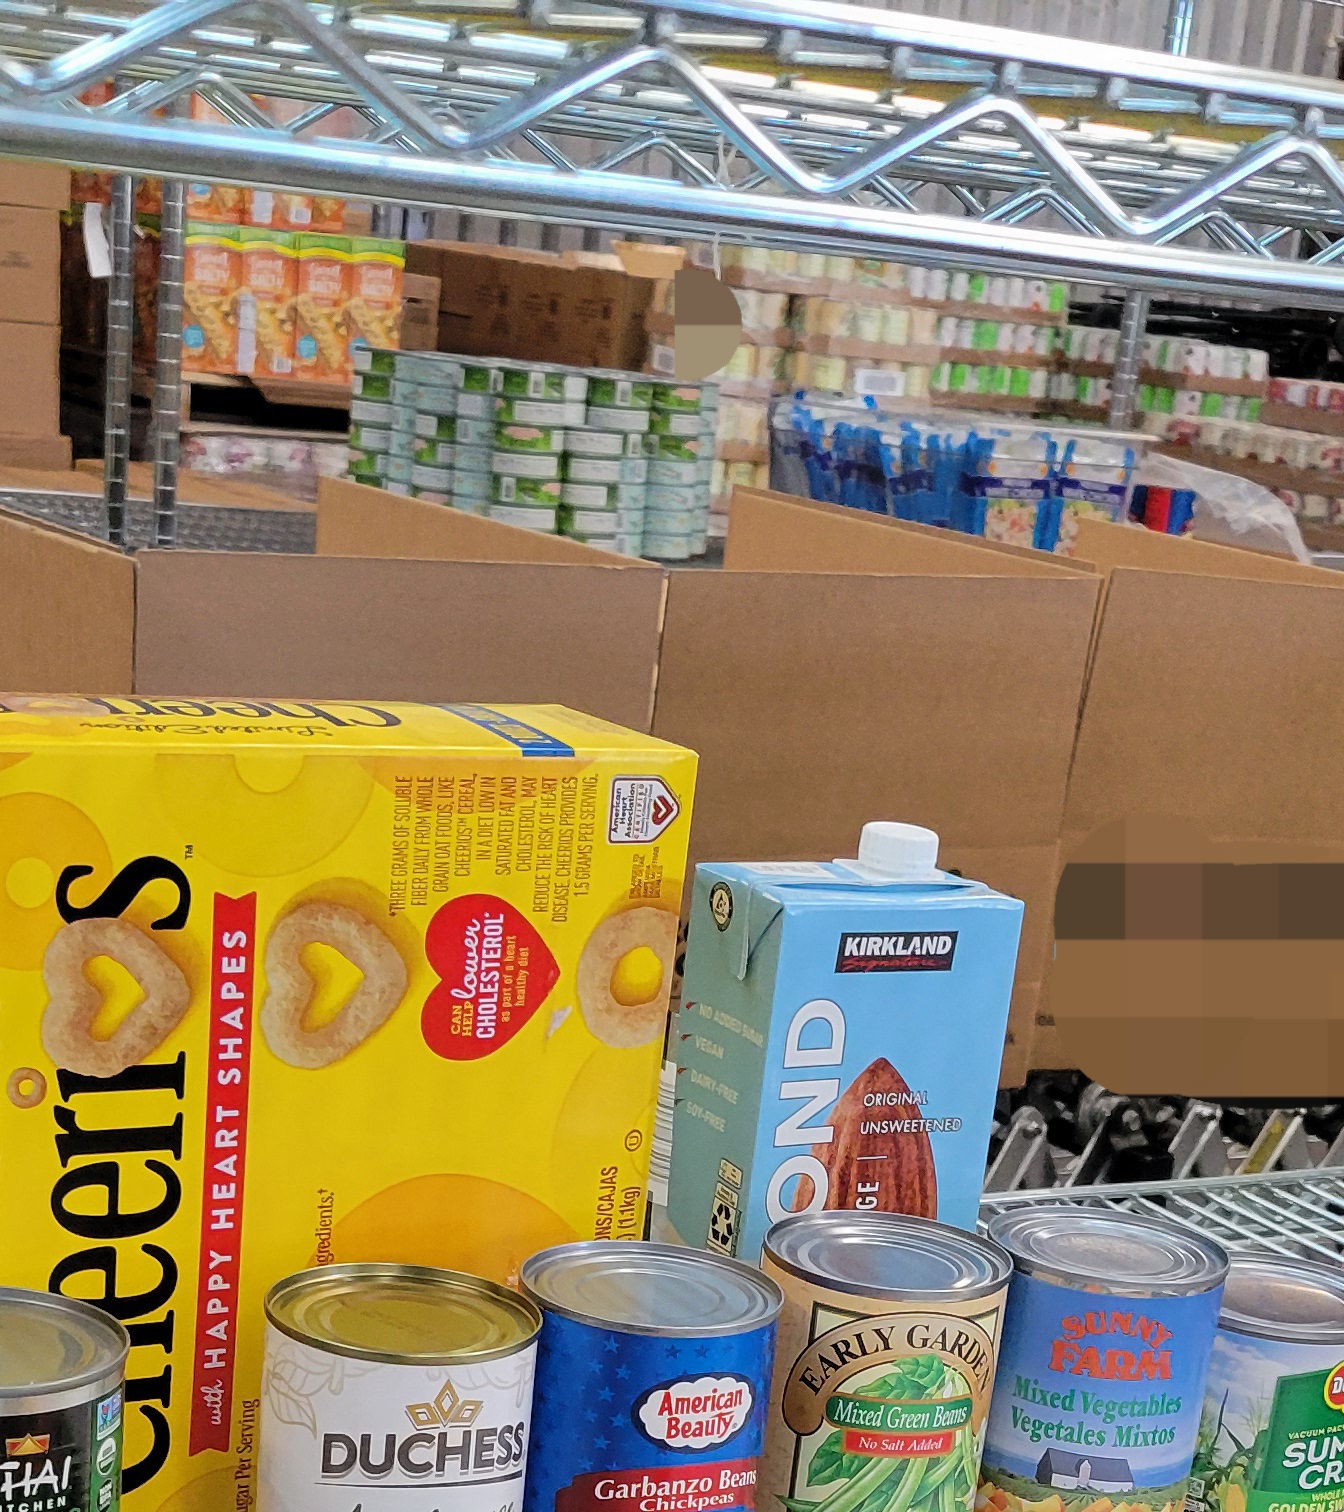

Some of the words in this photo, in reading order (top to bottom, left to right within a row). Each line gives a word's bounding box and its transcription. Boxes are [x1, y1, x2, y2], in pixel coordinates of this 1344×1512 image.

[417, 776, 433, 813] WHOLE
[520, 777, 537, 797] MAY
[612, 788, 621, 833] American
[625, 783, 635, 838] Association
[415, 817, 431, 844] FROM
[414, 848, 430, 874] DAILY
[412, 878, 428, 906] FIBER
[452, 919, 480, 1001] lower
[844, 935, 952, 957] KIRKLAND
[217, 931, 250, 1085] SHAPES
[450, 1005, 462, 1034] CAN
[461, 1002, 472, 1037] HELP
[863, 1092, 928, 1106] ORIGINAL
[860, 1118, 961, 1134] UNSWEETENED
[210, 1104, 240, 1231] HEART
[203, 1241, 235, 1368] HAPPY
[1062, 1312, 1173, 1349] SUNNY
[799, 1326, 896, 1395] EARLY
[906, 1324, 992, 1393] GARDEN
[1048, 1339, 1173, 1380] FARM
[209, 1366, 224, 1426] with
[658, 1388, 743, 1416] American
[834, 1399, 882, 1428] Mixed
[886, 1406, 931, 1428] Green
[933, 1404, 968, 1427] Beans
[1012, 1375, 1076, 1411] Mixed
[1081, 1392, 1182, 1423] Vegetables
[238, 1401, 257, 1454] Serving
[666, 1410, 735, 1439] Beauty
[1012, 1405, 1106, 1446] Vegetales
[1112, 1424, 1176, 1447] Mixtos
[321, 1421, 525, 1478] DUCHESS
[858, 1436, 878, 1450] No
[881, 1437, 904, 1450] Salt
[907, 1437, 943, 1451] Added
[237, 1456, 251, 1476] Per
[595, 1476, 713, 1500] Garbanzo
[719, 1469, 757, 1490] Beans
[639, 1492, 734, 1512] Chickpeas
